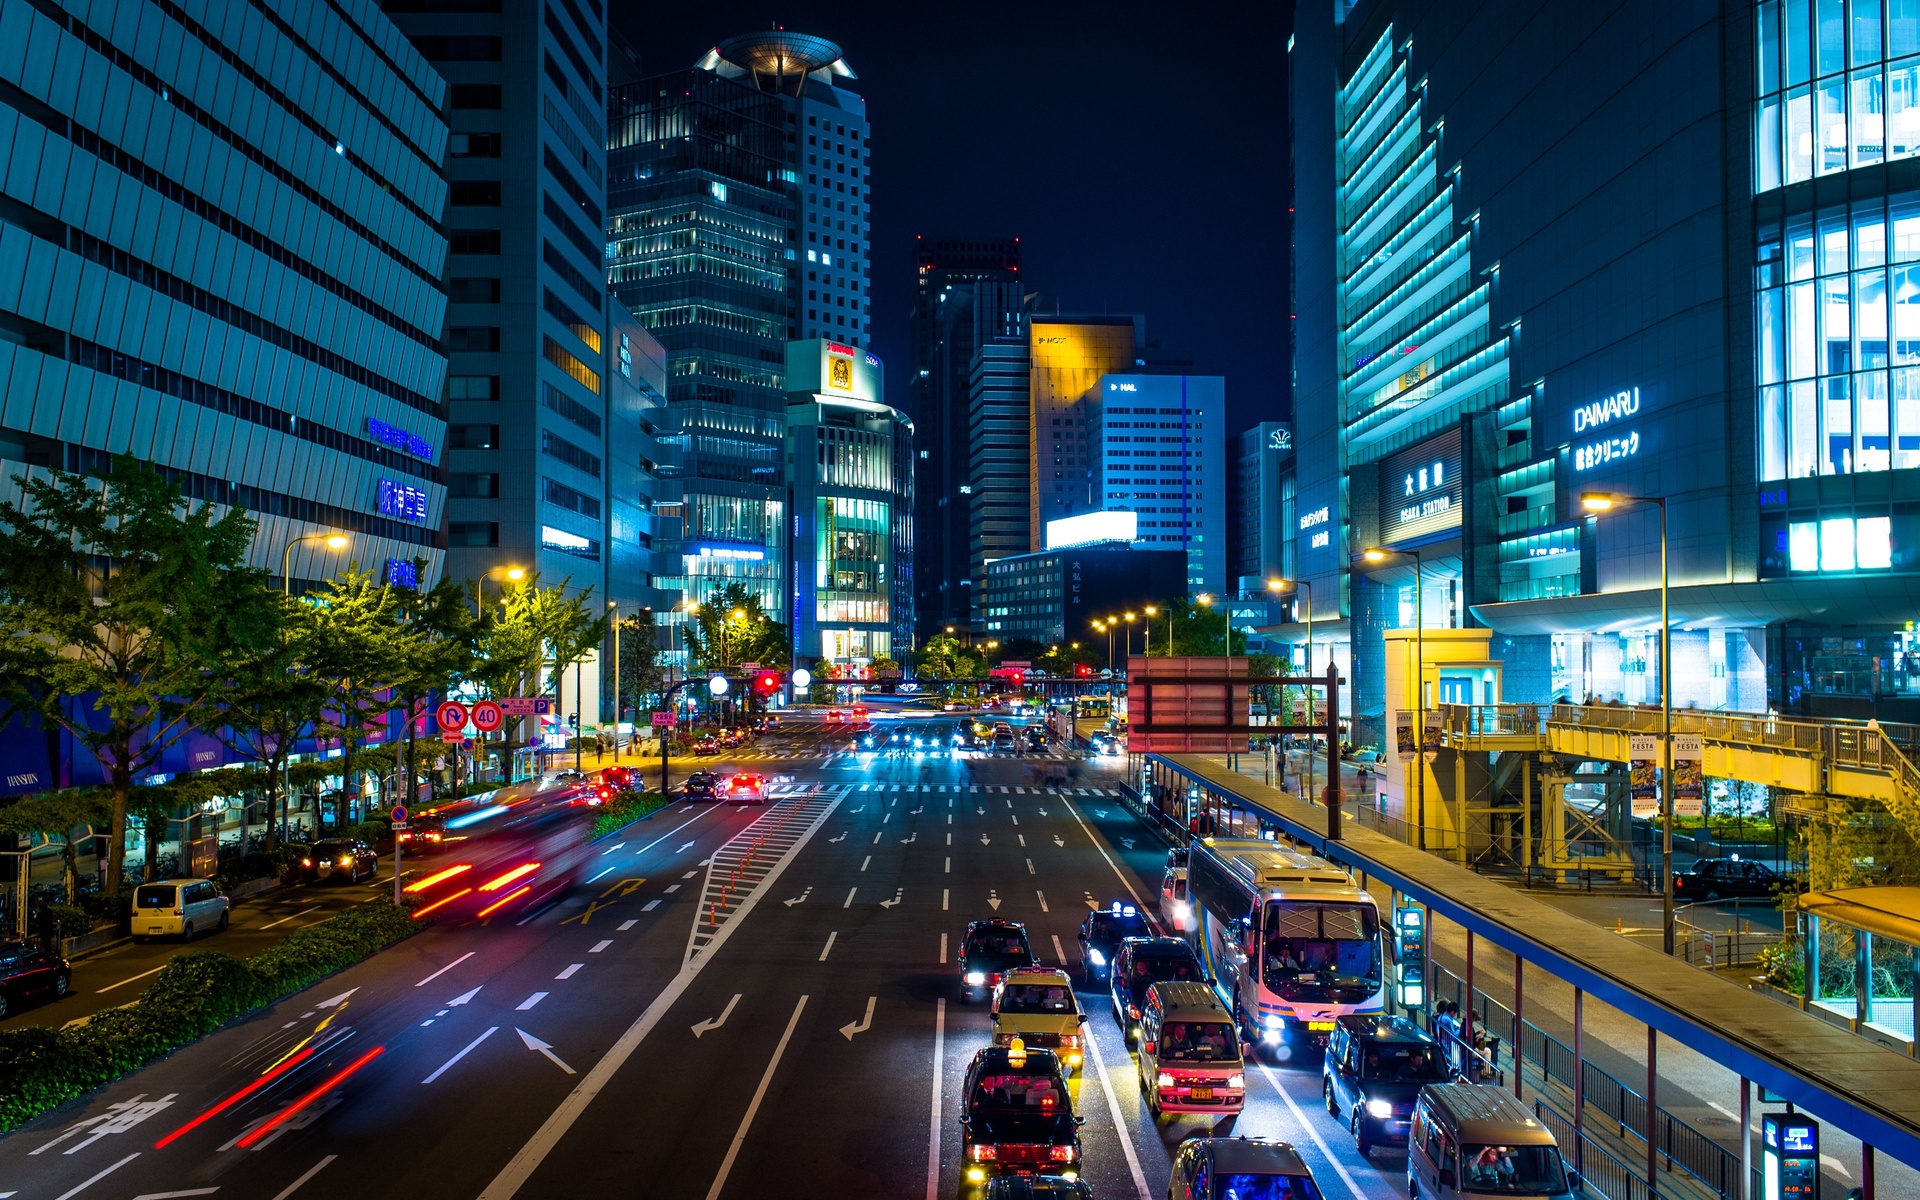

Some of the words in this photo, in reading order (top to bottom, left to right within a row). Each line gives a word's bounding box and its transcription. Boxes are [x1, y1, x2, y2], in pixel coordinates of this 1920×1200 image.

[1120, 383, 1137, 392] HAL
[1574, 386, 1640, 433] DAIMARU
[1575, 430, 1639, 472] 総合クリニック
[1400, 505, 1421, 523] OSAKA
[1423, 496, 1450, 516] STATION
[537, 701, 546, 712] P
[478, 709, 496, 724] 40
[662, 728, 668, 736] P
[195, 751, 216, 762] HANSHIN
[7, 773, 39, 787] HANSHIN
